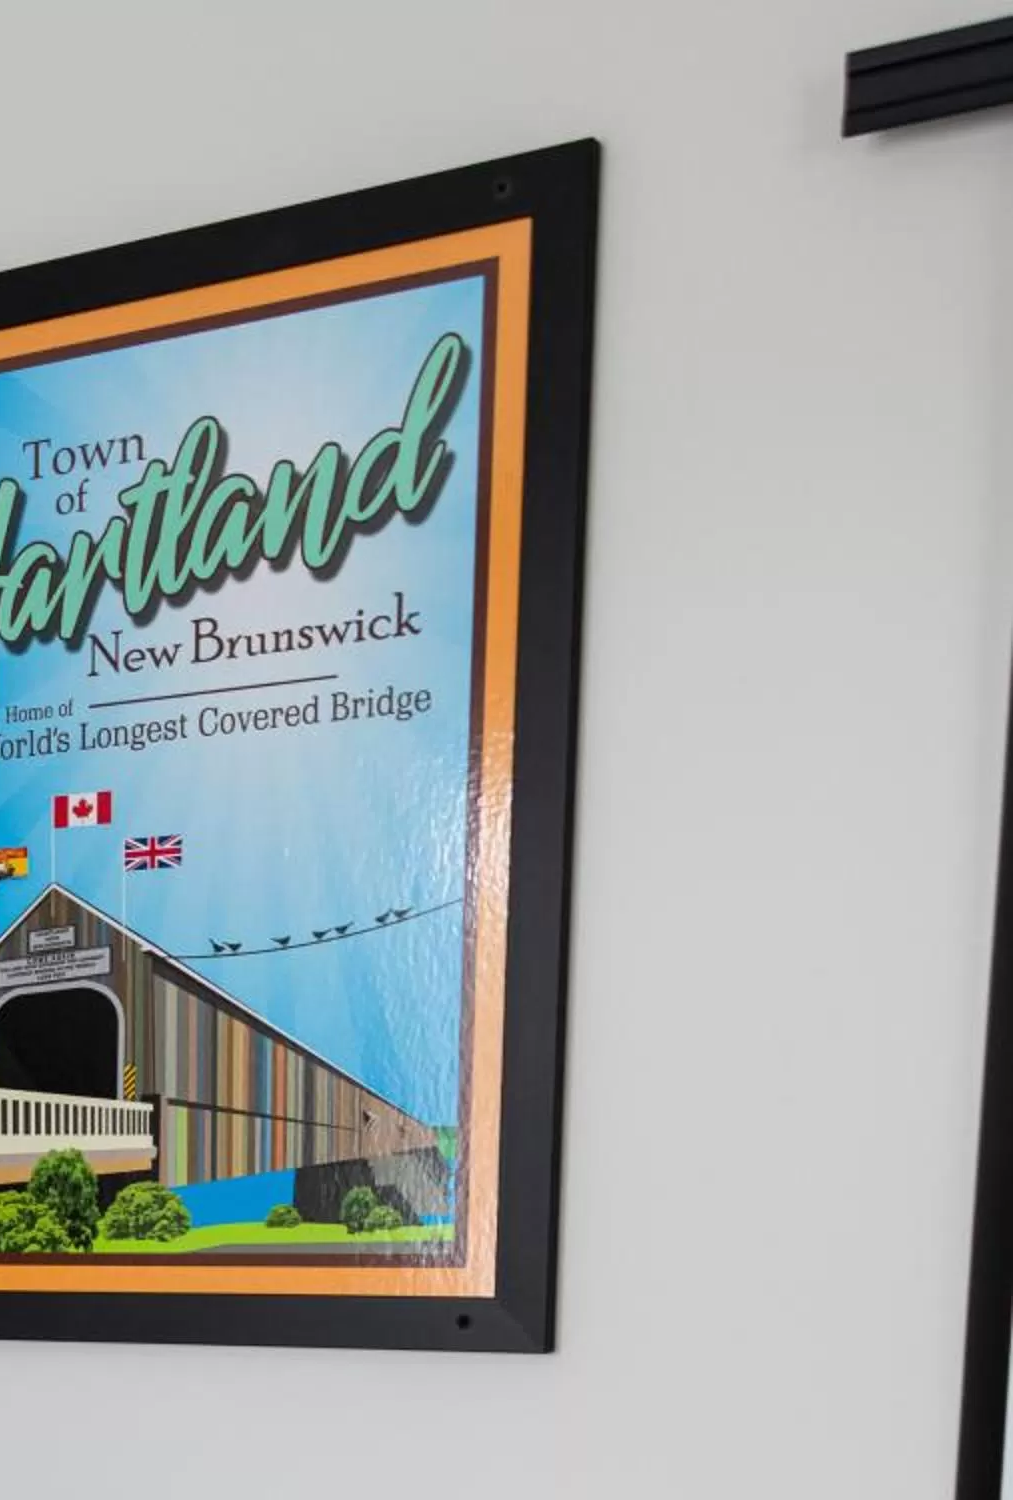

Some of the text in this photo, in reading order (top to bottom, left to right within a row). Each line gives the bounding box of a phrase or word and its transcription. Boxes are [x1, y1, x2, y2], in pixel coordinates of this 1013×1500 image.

[22, 433, 147, 482] Town
[54, 480, 90, 517] of
[87, 592, 422, 678] New Brunswick
[5, 698, 74, 724] Home of
[79, 713, 188, 751] Longest
[198, 695, 320, 738] Covered
[331, 685, 432, 722] Bridge
